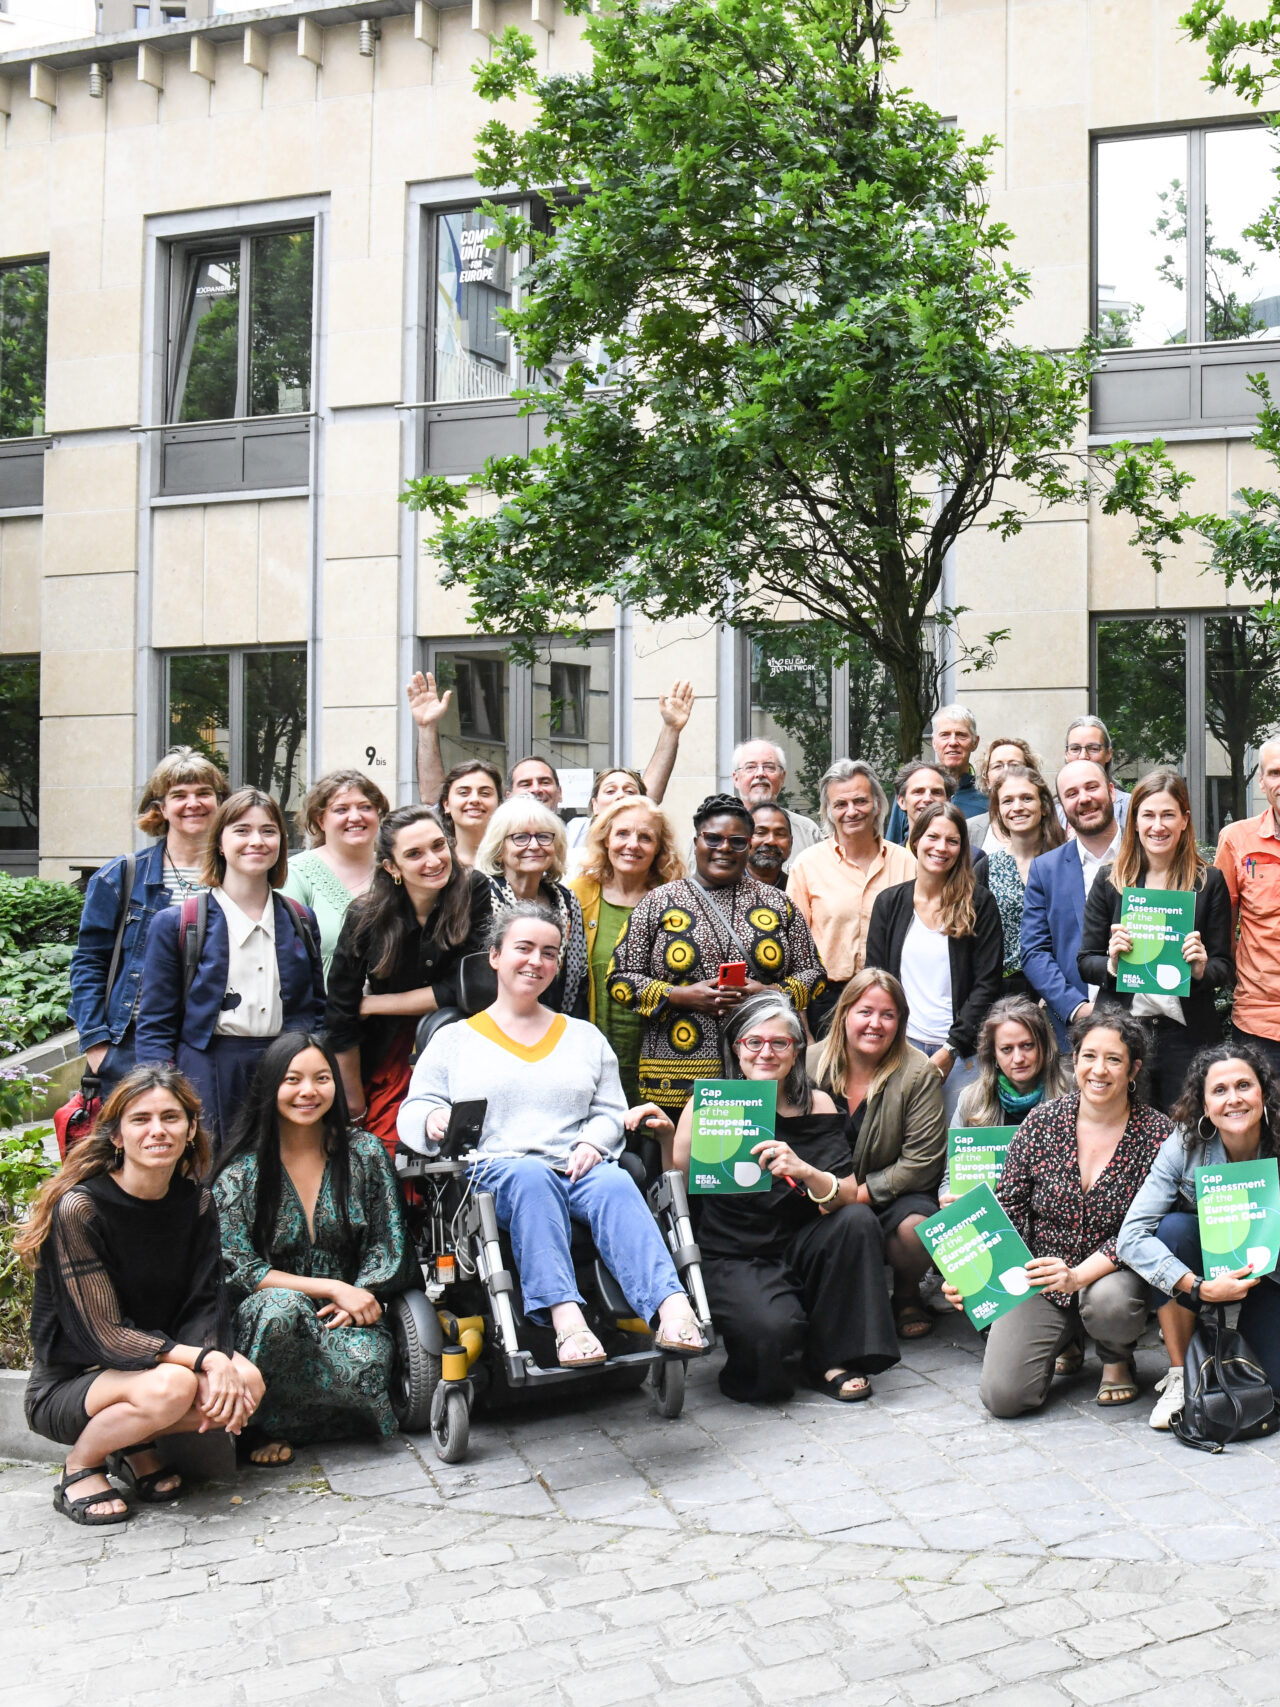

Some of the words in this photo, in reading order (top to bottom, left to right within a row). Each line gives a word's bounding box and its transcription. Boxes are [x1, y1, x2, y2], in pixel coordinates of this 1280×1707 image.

[459, 268, 494, 283] EUROPE
[784, 664, 816, 672] NETWORK
[365, 746, 376, 766] 9
[376, 757, 387, 766] bis
[1128, 895, 1146, 904] Gap
[1127, 904, 1183, 915] Assessment
[1126, 922, 1173, 932] European
[1157, 933, 1180, 942] Deal
[700, 1088, 722, 1098] Gap
[700, 1098, 763, 1106] Assessment
[700, 1108, 711, 1116] of
[712, 1108, 729, 1116] the
[699, 1118, 752, 1128] European
[699, 1127, 732, 1136] Green
[734, 1127, 760, 1136] Deal
[954, 1136, 974, 1145] Gap
[954, 1152, 964, 1162] of
[966, 1154, 982, 1162] the
[954, 1162, 1003, 1172] European
[954, 1172, 985, 1180] Green
[987, 1171, 1001, 1179] De
[1201, 1175, 1222, 1184] Gap
[1202, 1179, 1266, 1194] Assessment
[1203, 1195, 1214, 1204] of
[1215, 1194, 1232, 1202] the
[1204, 1201, 1258, 1214] European
[1205, 1214, 1239, 1225] Green
[1241, 1209, 1266, 1220] Deal
[925, 1222, 946, 1238] Gap
[931, 1206, 988, 1247] Assessment
[936, 1244, 946, 1255] of
[947, 1235, 963, 1249] the
[940, 1230, 990, 1264] European
[947, 1250, 978, 1273] Green
[977, 1233, 1002, 1253] Deal
